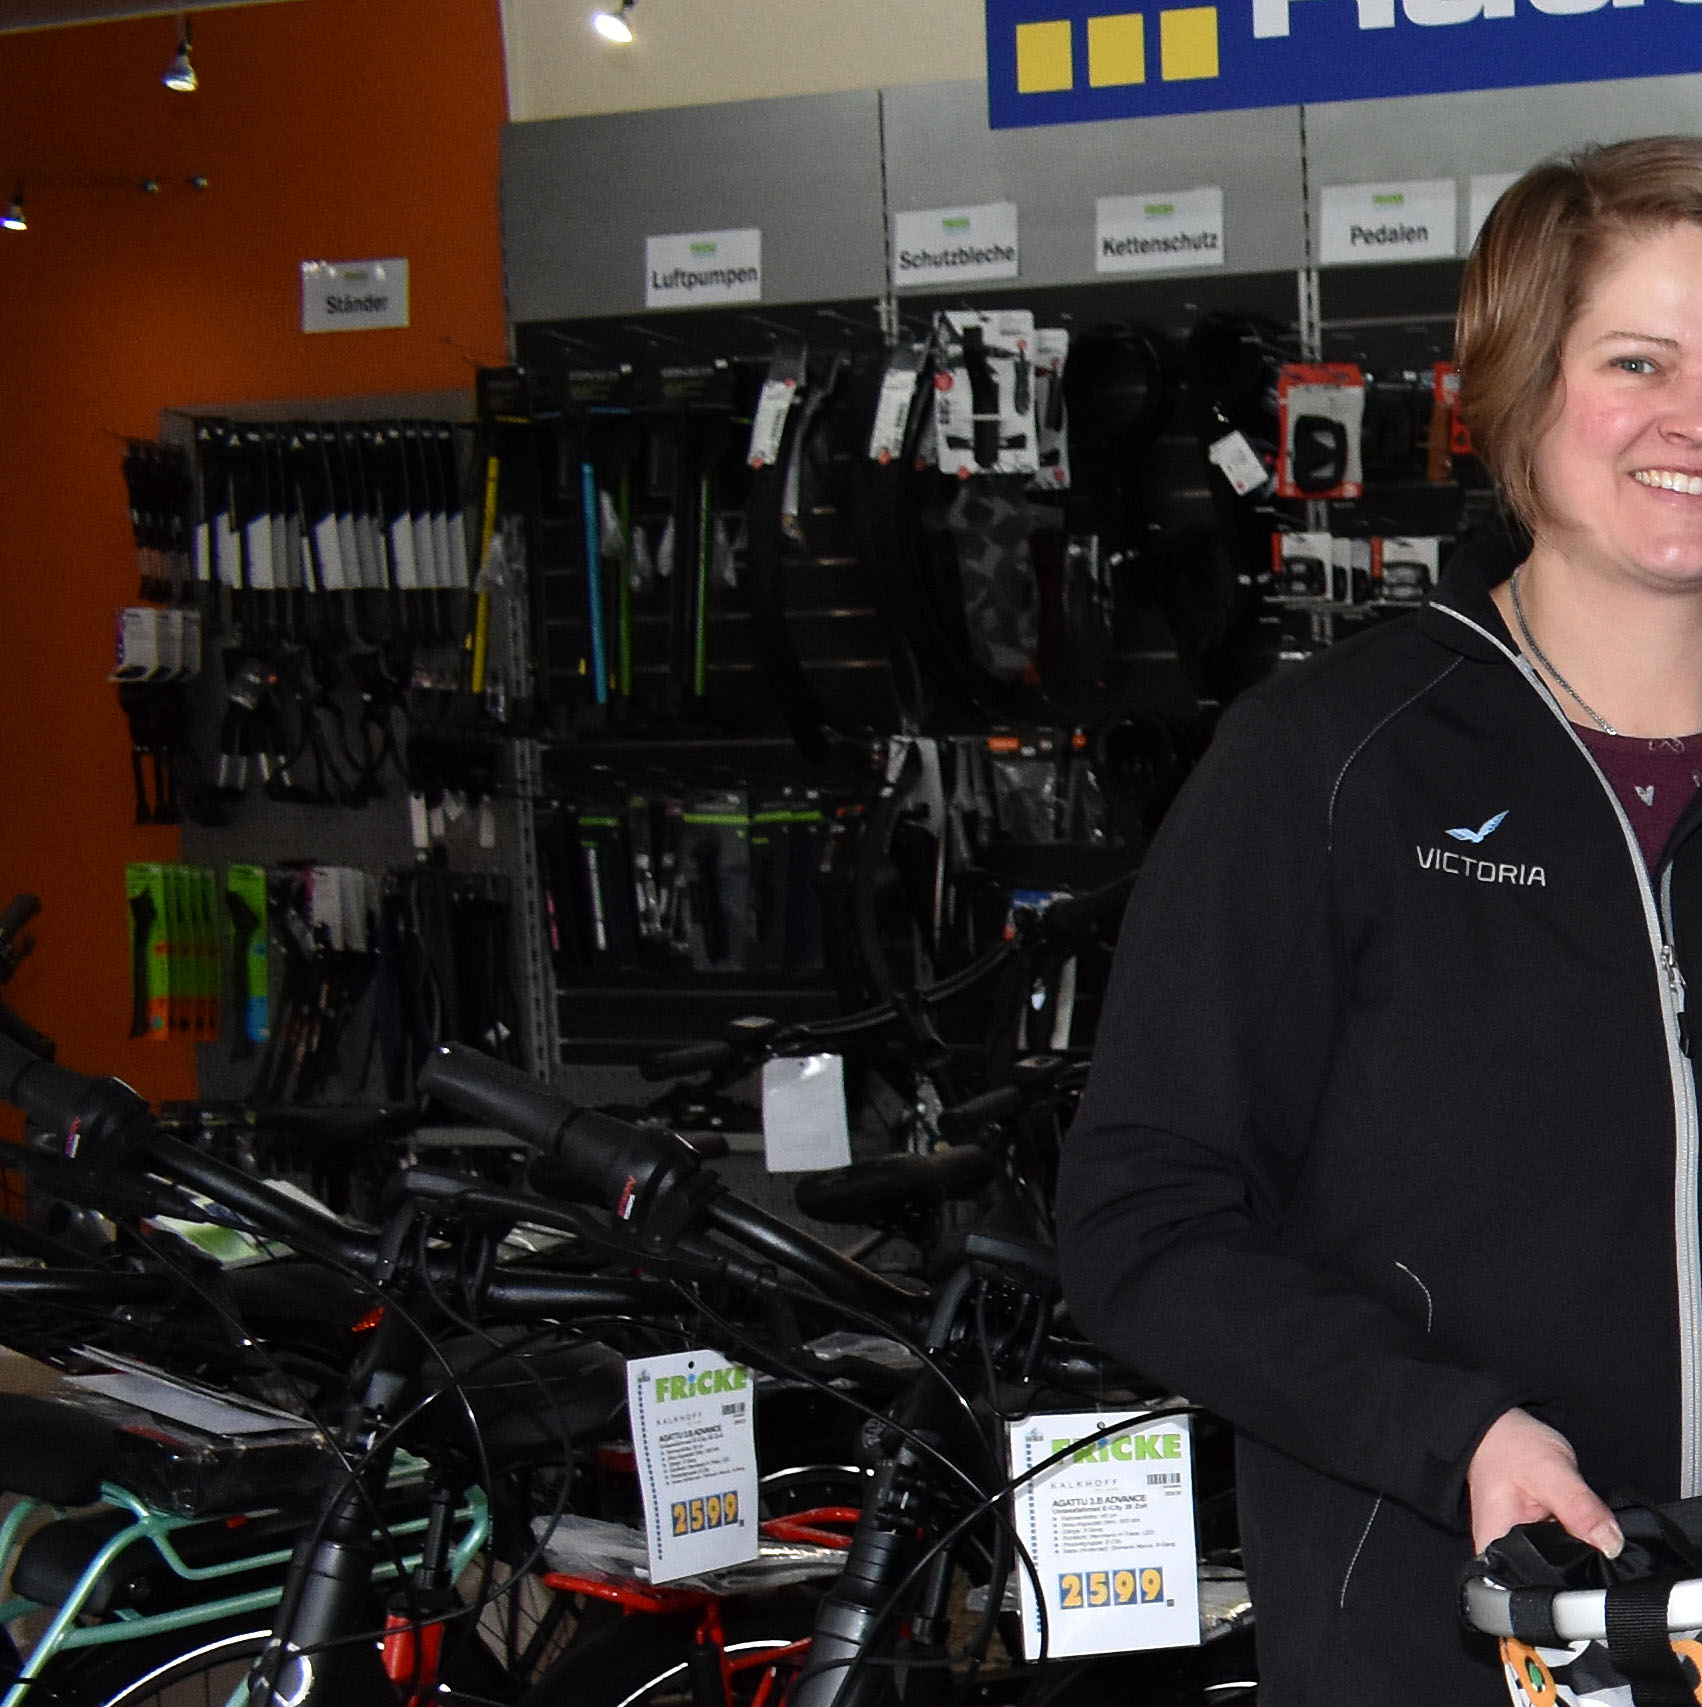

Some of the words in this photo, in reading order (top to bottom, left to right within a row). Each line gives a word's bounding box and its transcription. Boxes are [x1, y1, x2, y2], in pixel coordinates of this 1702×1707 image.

[1102, 230, 1218, 258] Kettenschutz
[1350, 223, 1428, 246] Pedalen
[899, 243, 1016, 270] Schutzbleche
[651, 264, 759, 292] Luftpumpen
[326, 294, 389, 315] Ständer
[1415, 845, 1547, 887] VICTORIA
[673, 1491, 738, 1536] 2599
[1052, 1497, 1088, 1508] AGATTU
[1059, 1567, 1165, 1609] 2599
